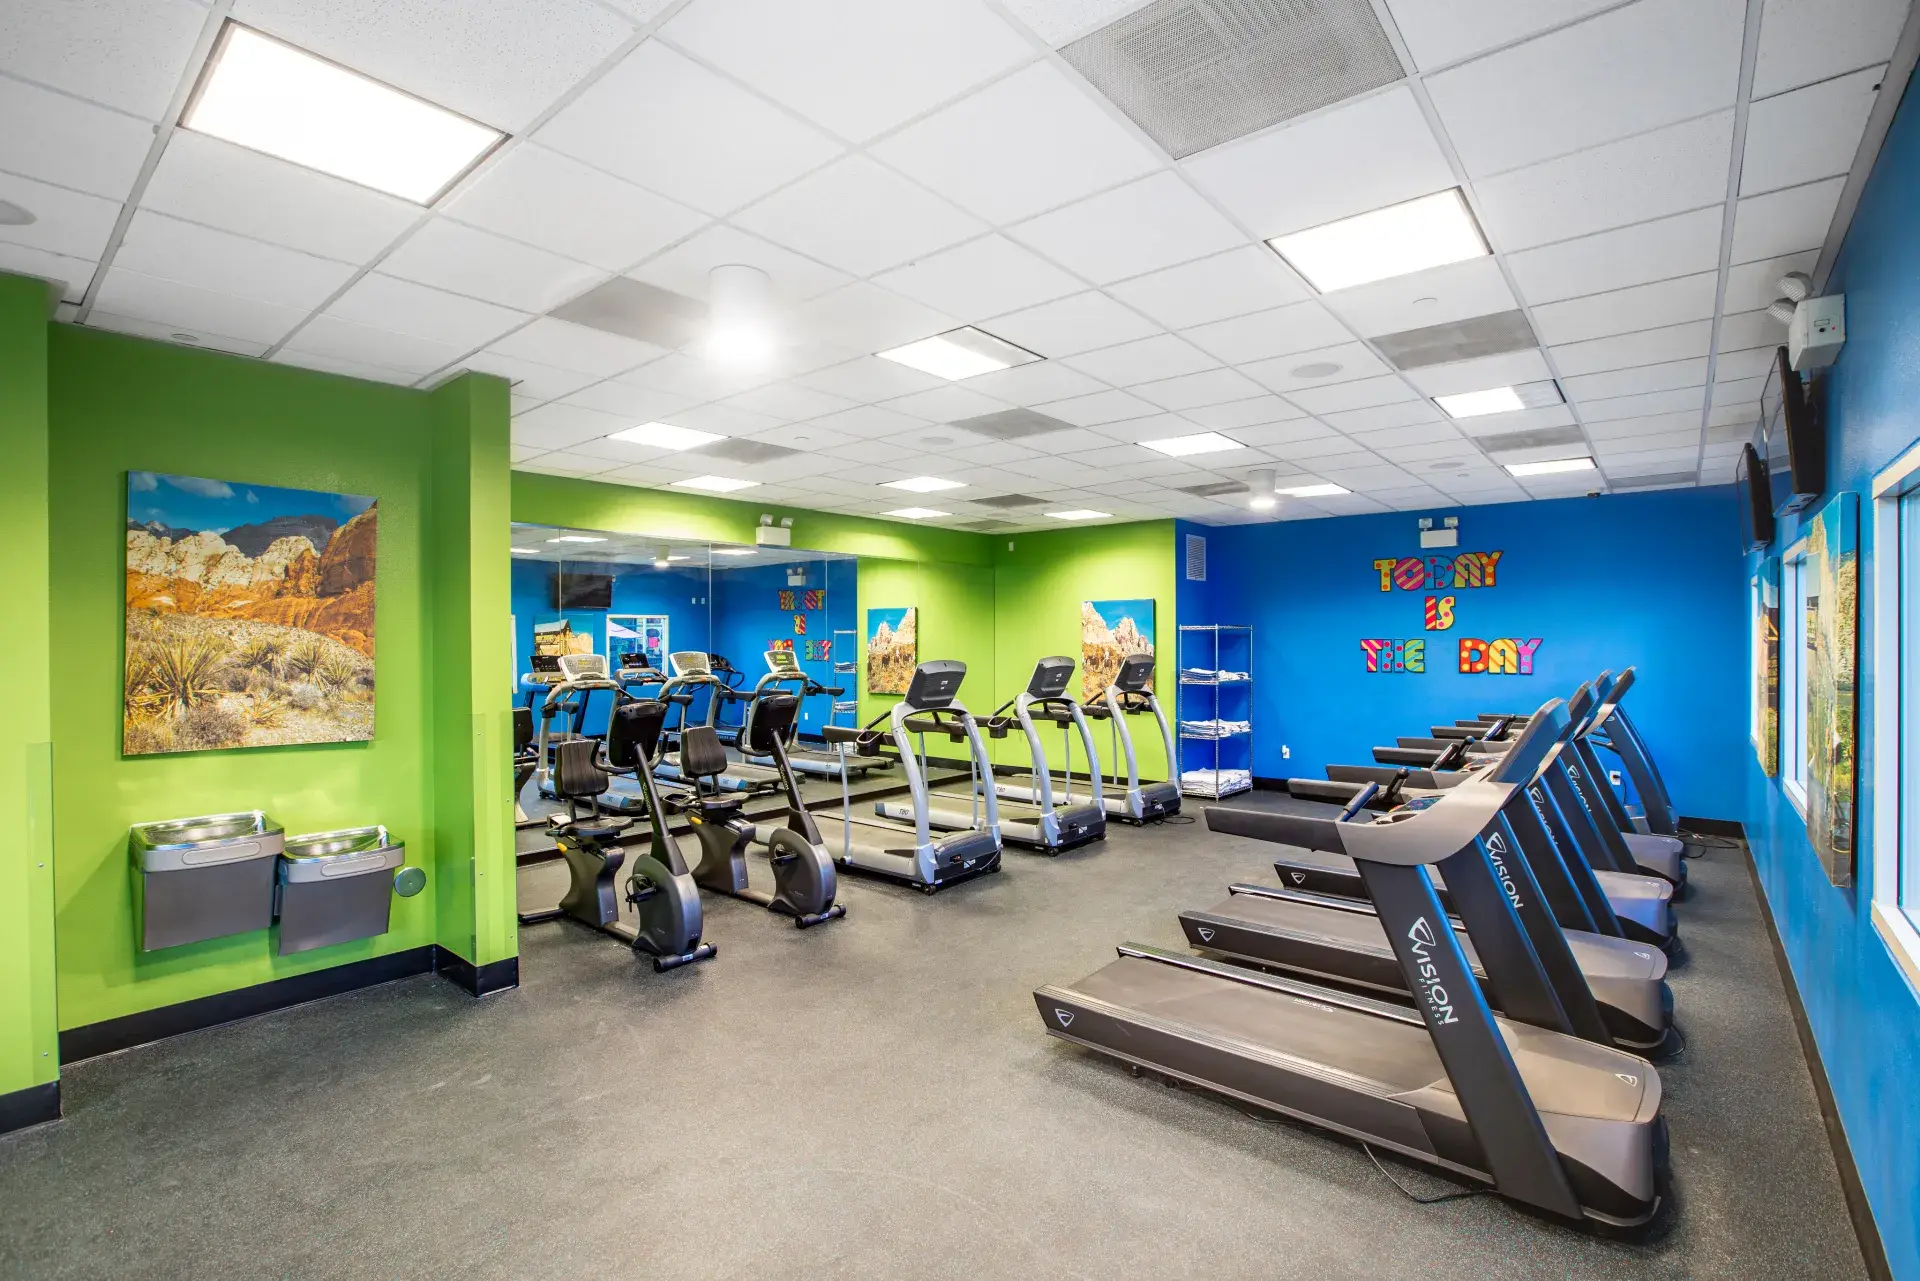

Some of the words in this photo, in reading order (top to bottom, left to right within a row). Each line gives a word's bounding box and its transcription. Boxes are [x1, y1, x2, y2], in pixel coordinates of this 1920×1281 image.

[1373, 551, 1504, 592] TODAY
[1425, 596, 1455, 631] IS
[1360, 638, 1425, 673] THE
[1458, 638, 1544, 675] DAY
[1488, 850, 1524, 909] VISION
[1411, 942, 1459, 1025] VISION
[1418, 977, 1445, 1026] FITNESS
